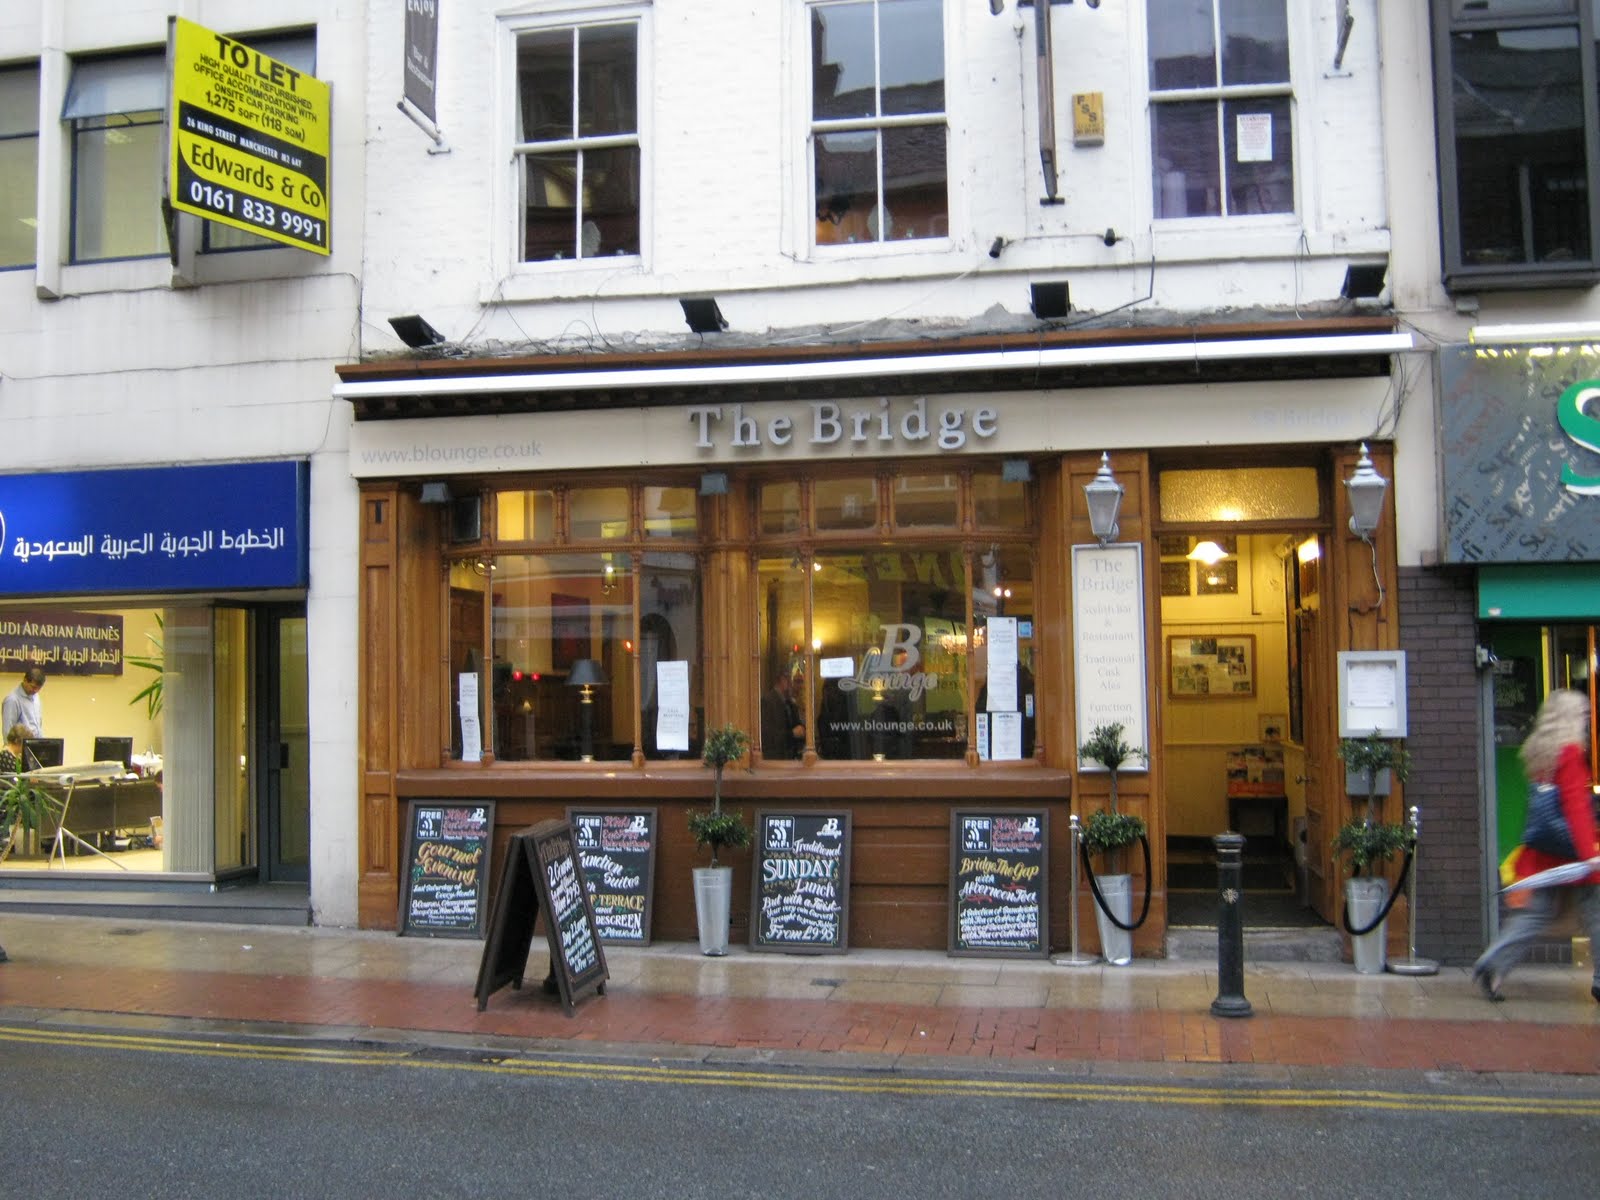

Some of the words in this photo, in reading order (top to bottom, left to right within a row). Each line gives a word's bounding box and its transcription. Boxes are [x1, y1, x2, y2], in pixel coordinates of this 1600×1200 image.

[215, 34, 249, 69] TO
[255, 53, 300, 92] LET
[194, 63, 224, 82] OFFICE
[227, 78, 296, 112] ACCOMMODATION
[299, 107, 317, 122] WITH
[200, 53, 220, 69] HIGH
[223, 63, 257, 85] QUALITY
[260, 80, 312, 109] REFURBISHED
[215, 83, 244, 102] ONSITE
[246, 95, 263, 110] CAR
[265, 103, 298, 124] PARKING
[238, 108, 259, 122] SQFT
[197, 121, 214, 134] KING
[215, 128, 236, 142] STREET
[240, 137, 278, 159] MANCHESTER
[192, 143, 274, 191] Edwards
[282, 177, 294, 198] &
[301, 184, 320, 207] Co
[191, 182, 234, 213] 0161
[242, 198, 275, 226] 833
[282, 212, 320, 241] 9991
[687, 404, 794, 448] The
[808, 398, 998, 449] Bridge
[362, 440, 542, 464] www.blounge.co.uk
[14, 535, 93, 563] السعودية
[101, 533, 153, 560] العربية
[160, 530, 213, 558] الجوية
[220, 528, 284, 555] الخطوط
[1090, 557, 1122, 573] The
[1081, 576, 1134, 594] Bridge
[0, 621, 20, 635] UDI
[22, 621, 73, 638] ARABIAN
[75, 625, 120, 640] AIRLINES
[876, 623, 922, 673] B
[838, 647, 938, 701] Lounge
[1090, 702, 1132, 712] Function
[830, 719, 953, 732] www.blounge.co.uk
[420, 812, 442, 820] FREE
[579, 818, 600, 827] FREE
[768, 820, 792, 828] FREE
[964, 820, 990, 830] FREE
[415, 842, 482, 865] Gourmet
[792, 838, 842, 857] Traditional
[424, 857, 476, 886] Evening
[762, 859, 834, 882] SUNDAY
[959, 856, 996, 876] Bridge
[996, 858, 1014, 877] The
[1012, 862, 1040, 881] Gap
[604, 872, 640, 889] Suites
[793, 878, 836, 898] Lunch
[599, 894, 645, 912] TERRACE
[959, 881, 1015, 903] Afternoon
[1014, 888, 1037, 904] Tea
[596, 913, 642, 930] DESCREEN
[766, 924, 802, 940] From
